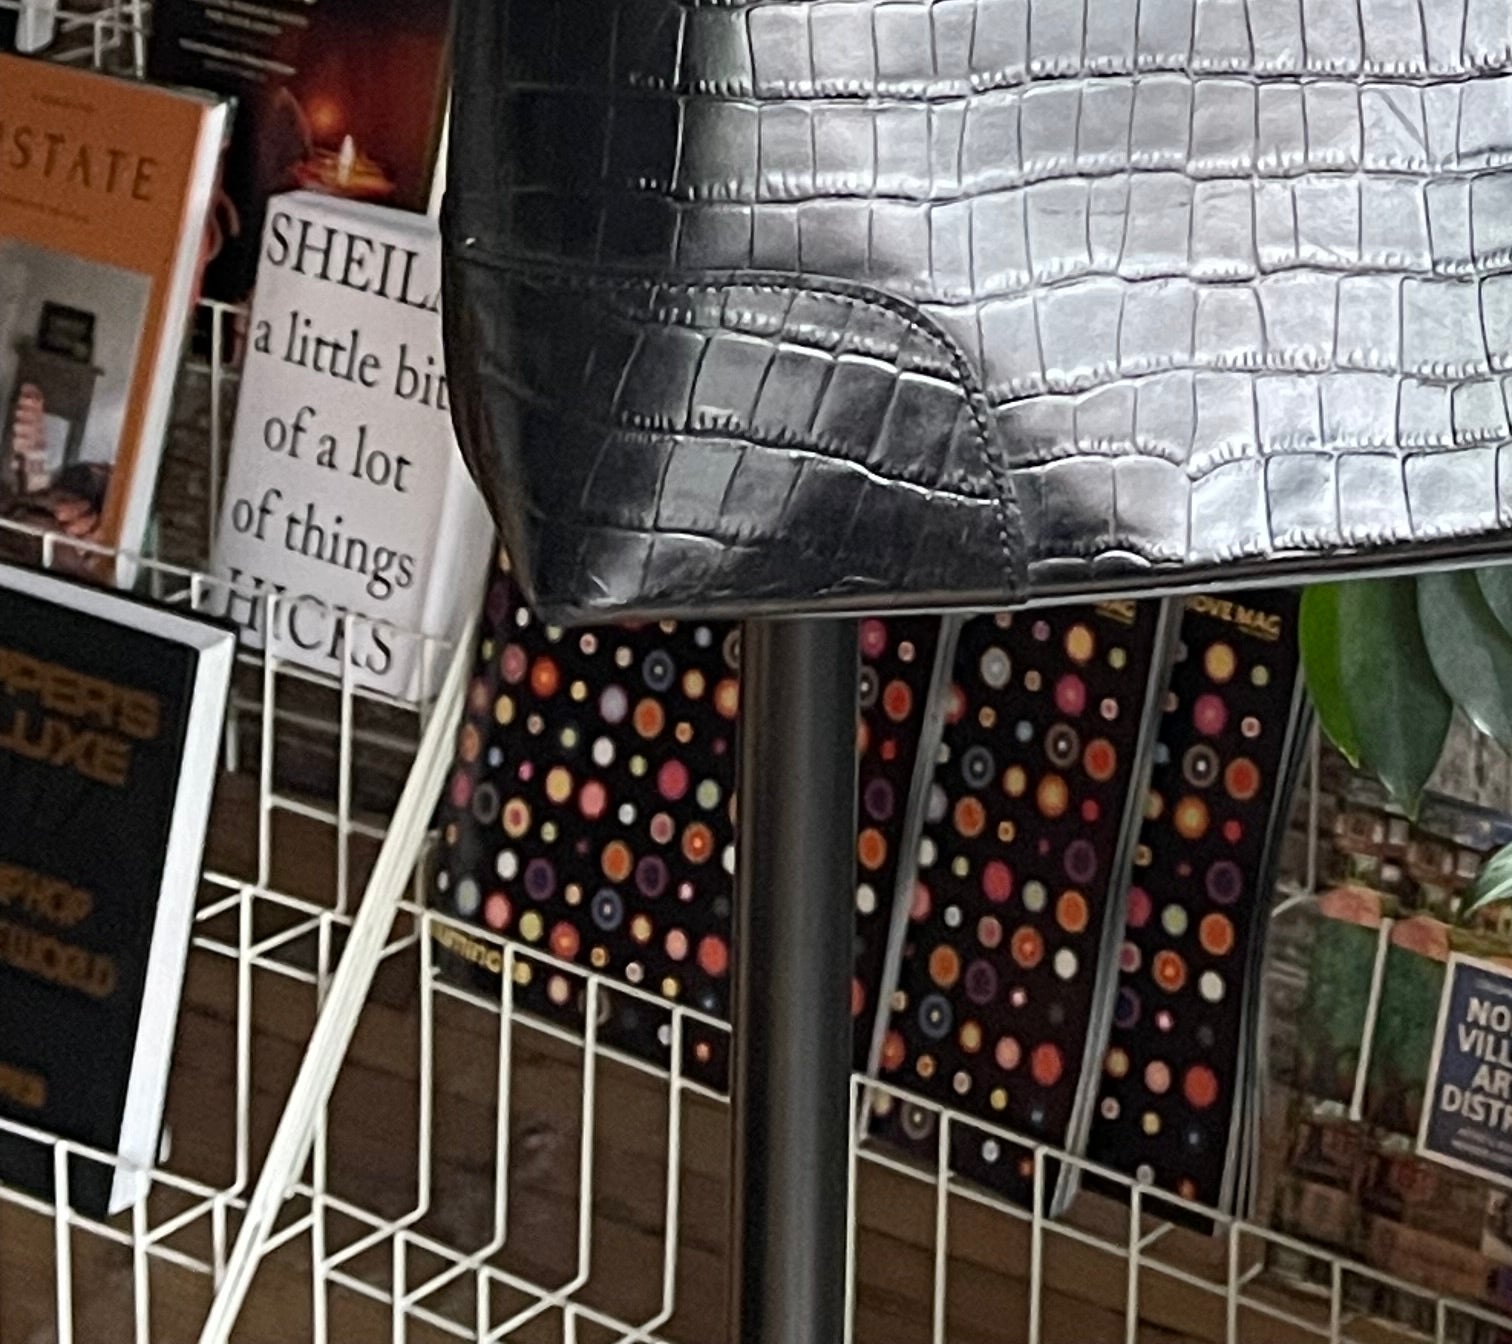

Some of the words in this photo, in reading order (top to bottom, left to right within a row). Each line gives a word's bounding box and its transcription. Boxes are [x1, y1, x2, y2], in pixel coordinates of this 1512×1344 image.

[0, 120, 158, 203] STATE
[266, 211, 440, 314] SHEIL
[254, 319, 271, 355] a
[283, 309, 382, 389] little
[394, 342, 449, 410] bit
[263, 405, 317, 459] of
[316, 433, 338, 471] a
[351, 423, 412, 494] lot
[231, 487, 283, 540] of
[284, 501, 415, 601] things
